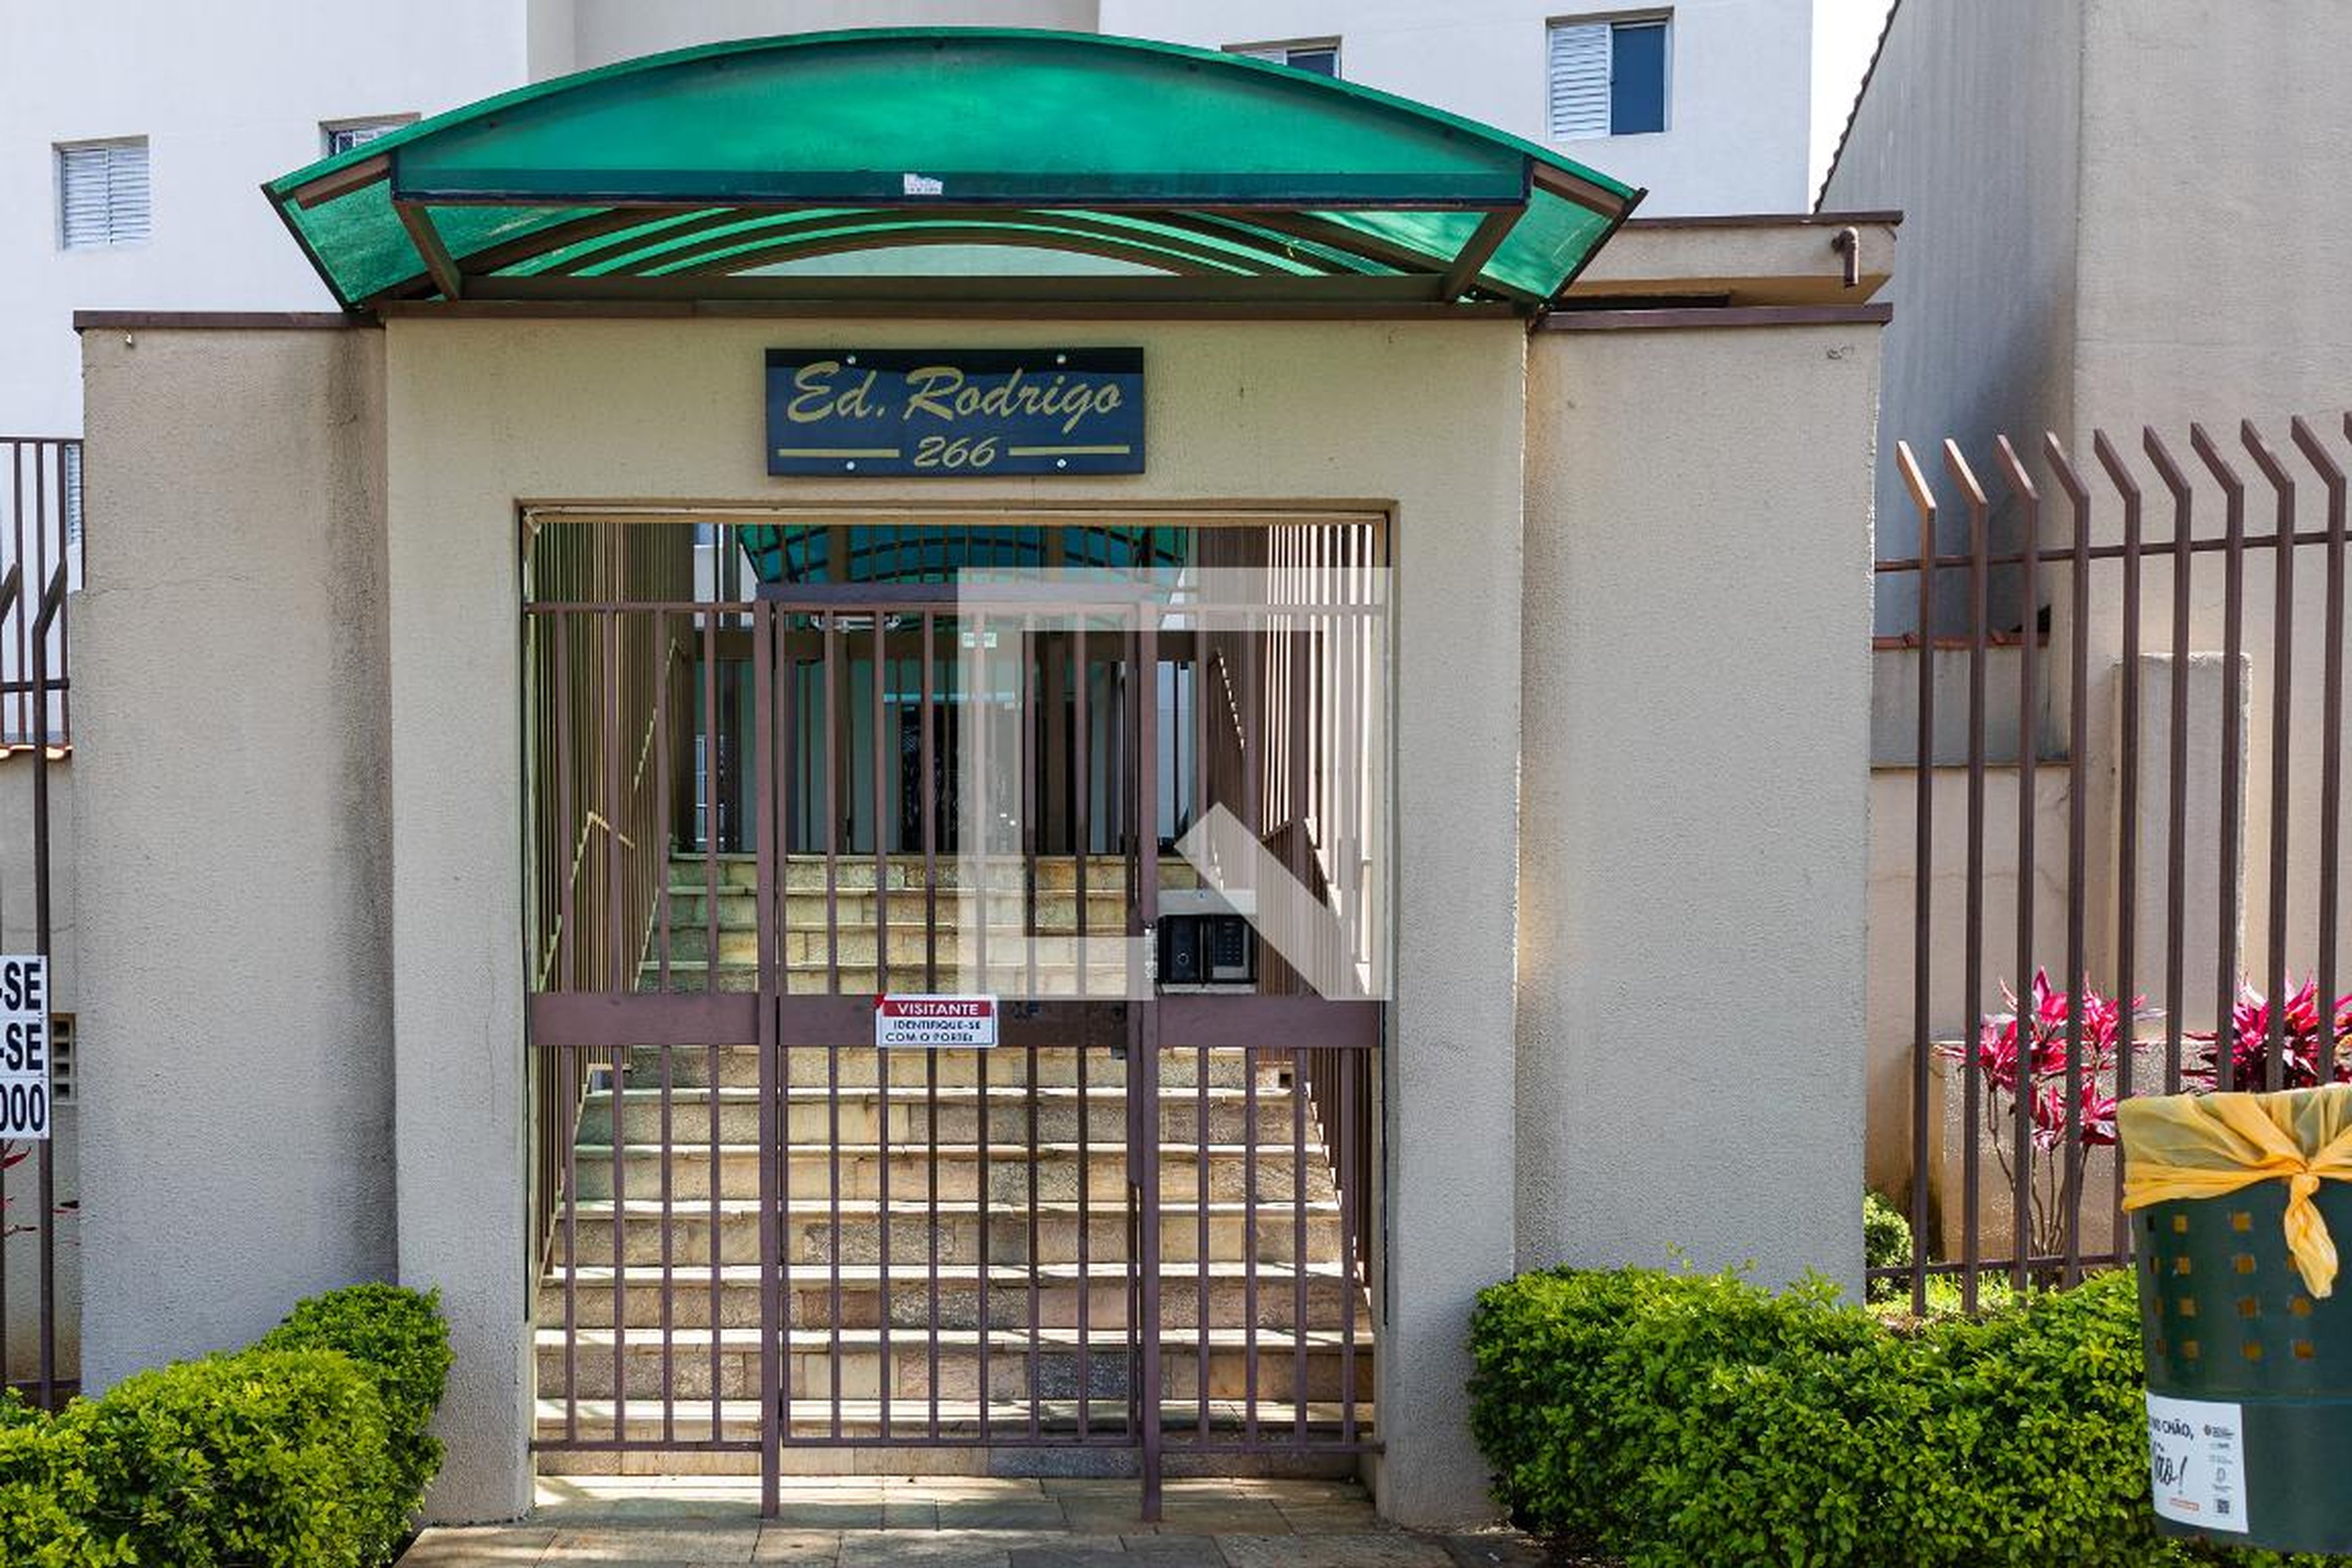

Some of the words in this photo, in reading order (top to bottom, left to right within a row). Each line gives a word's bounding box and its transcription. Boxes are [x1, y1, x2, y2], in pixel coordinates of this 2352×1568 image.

[786, 361, 885, 423] Ed.
[903, 365, 1122, 434] Rodrigo
[914, 436, 1000, 469] 266
[897, 1003, 979, 1015] VISITANTE
[893, 1020, 981, 1030] IDENTIFIQUE-SE
[886, 1033, 916, 1041] COM
[920, 1033, 930, 1041] O
